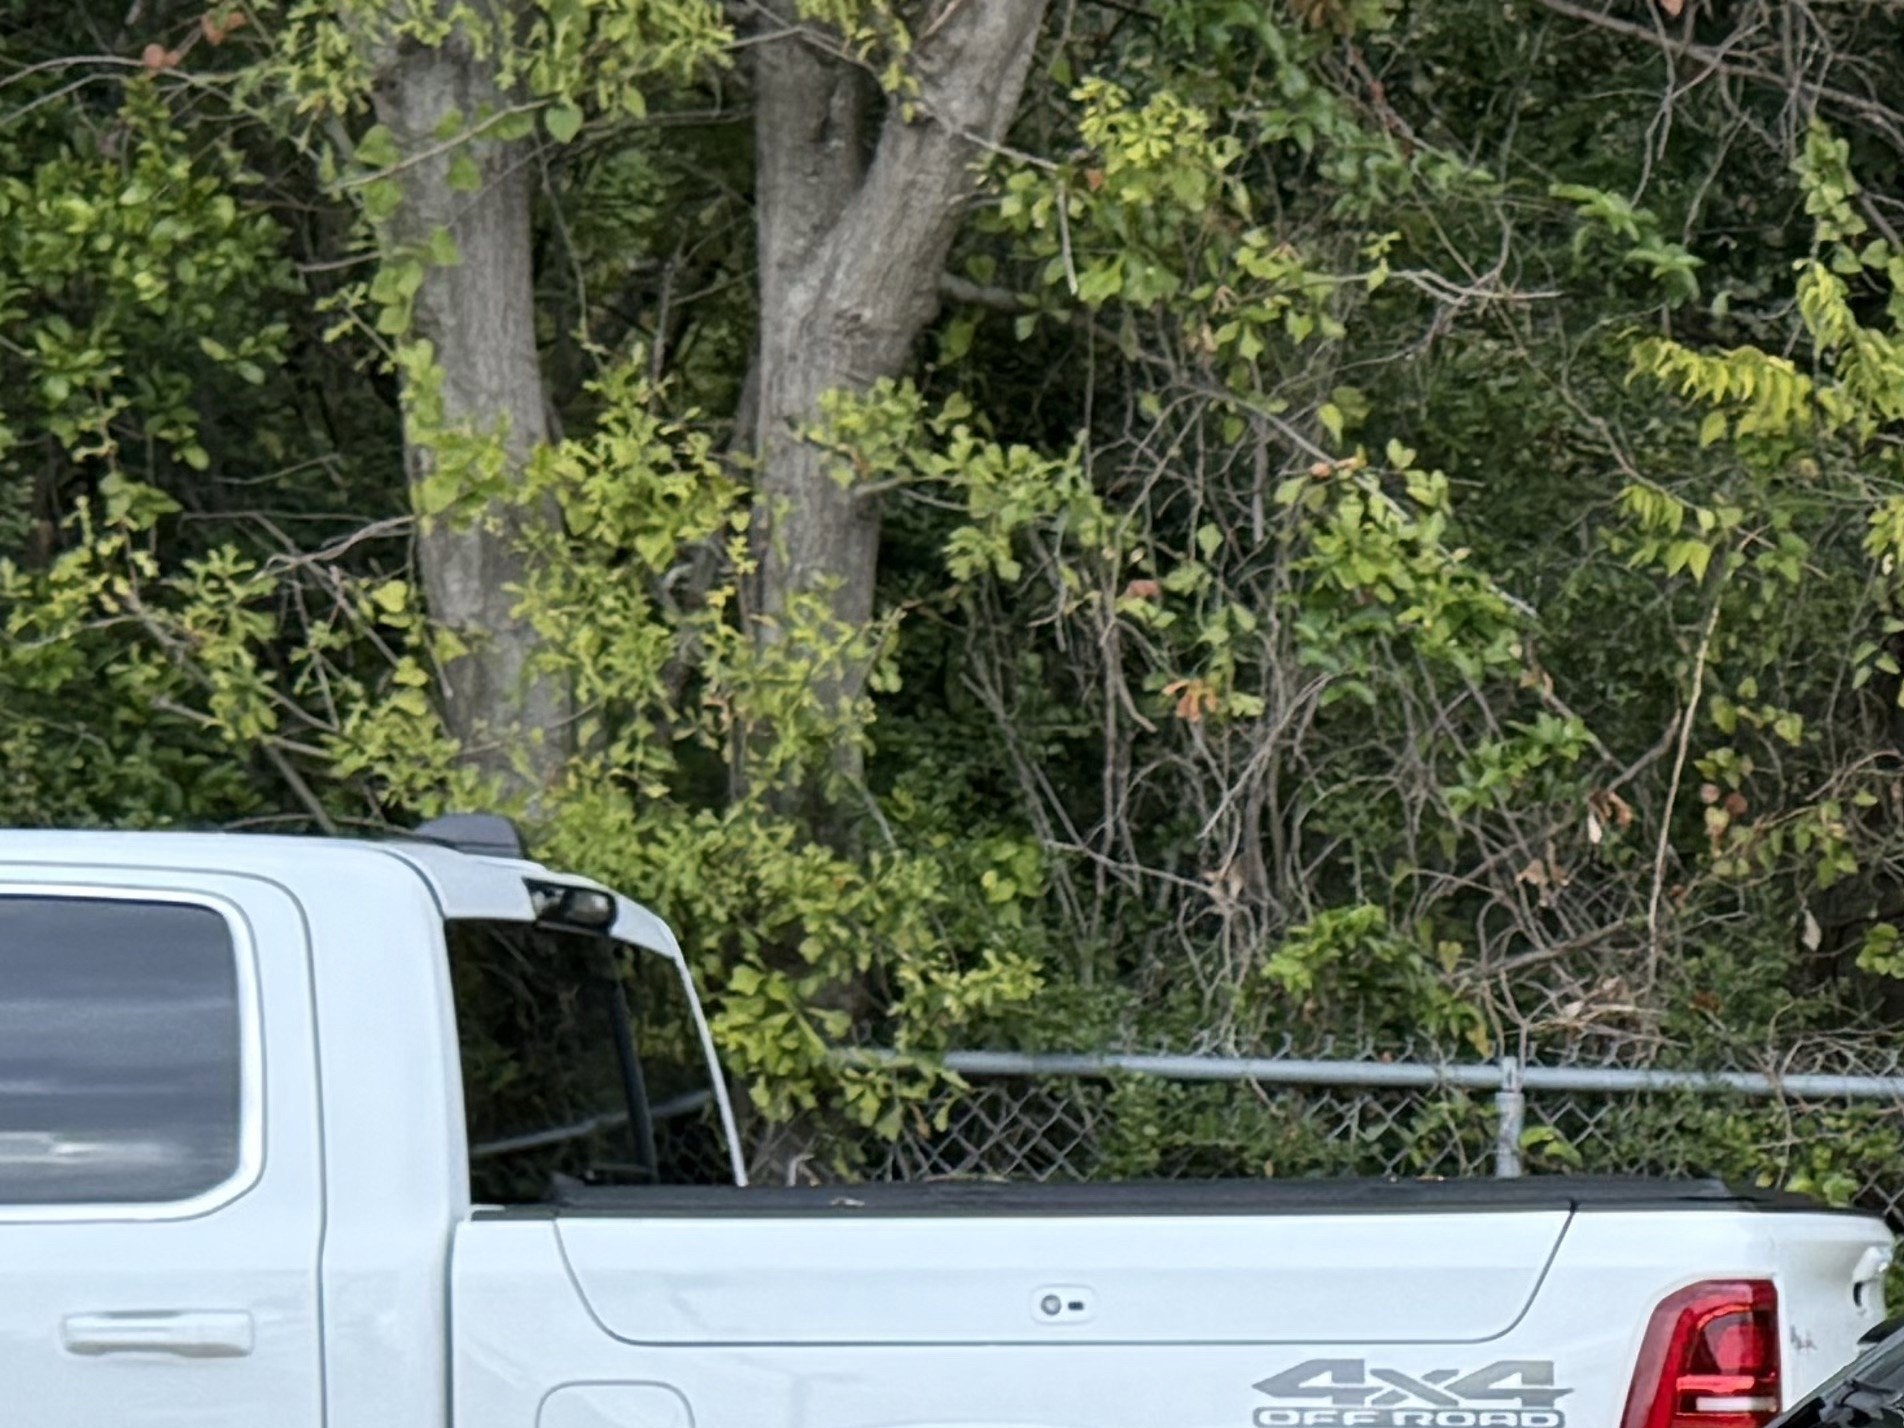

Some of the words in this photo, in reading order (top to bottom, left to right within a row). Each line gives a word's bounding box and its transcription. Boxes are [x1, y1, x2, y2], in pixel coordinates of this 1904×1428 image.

[1252, 1358, 1575, 1407] 4x4
[1258, 1409, 1378, 1426] OFF
[1393, 1410, 1560, 1428] ROAD
